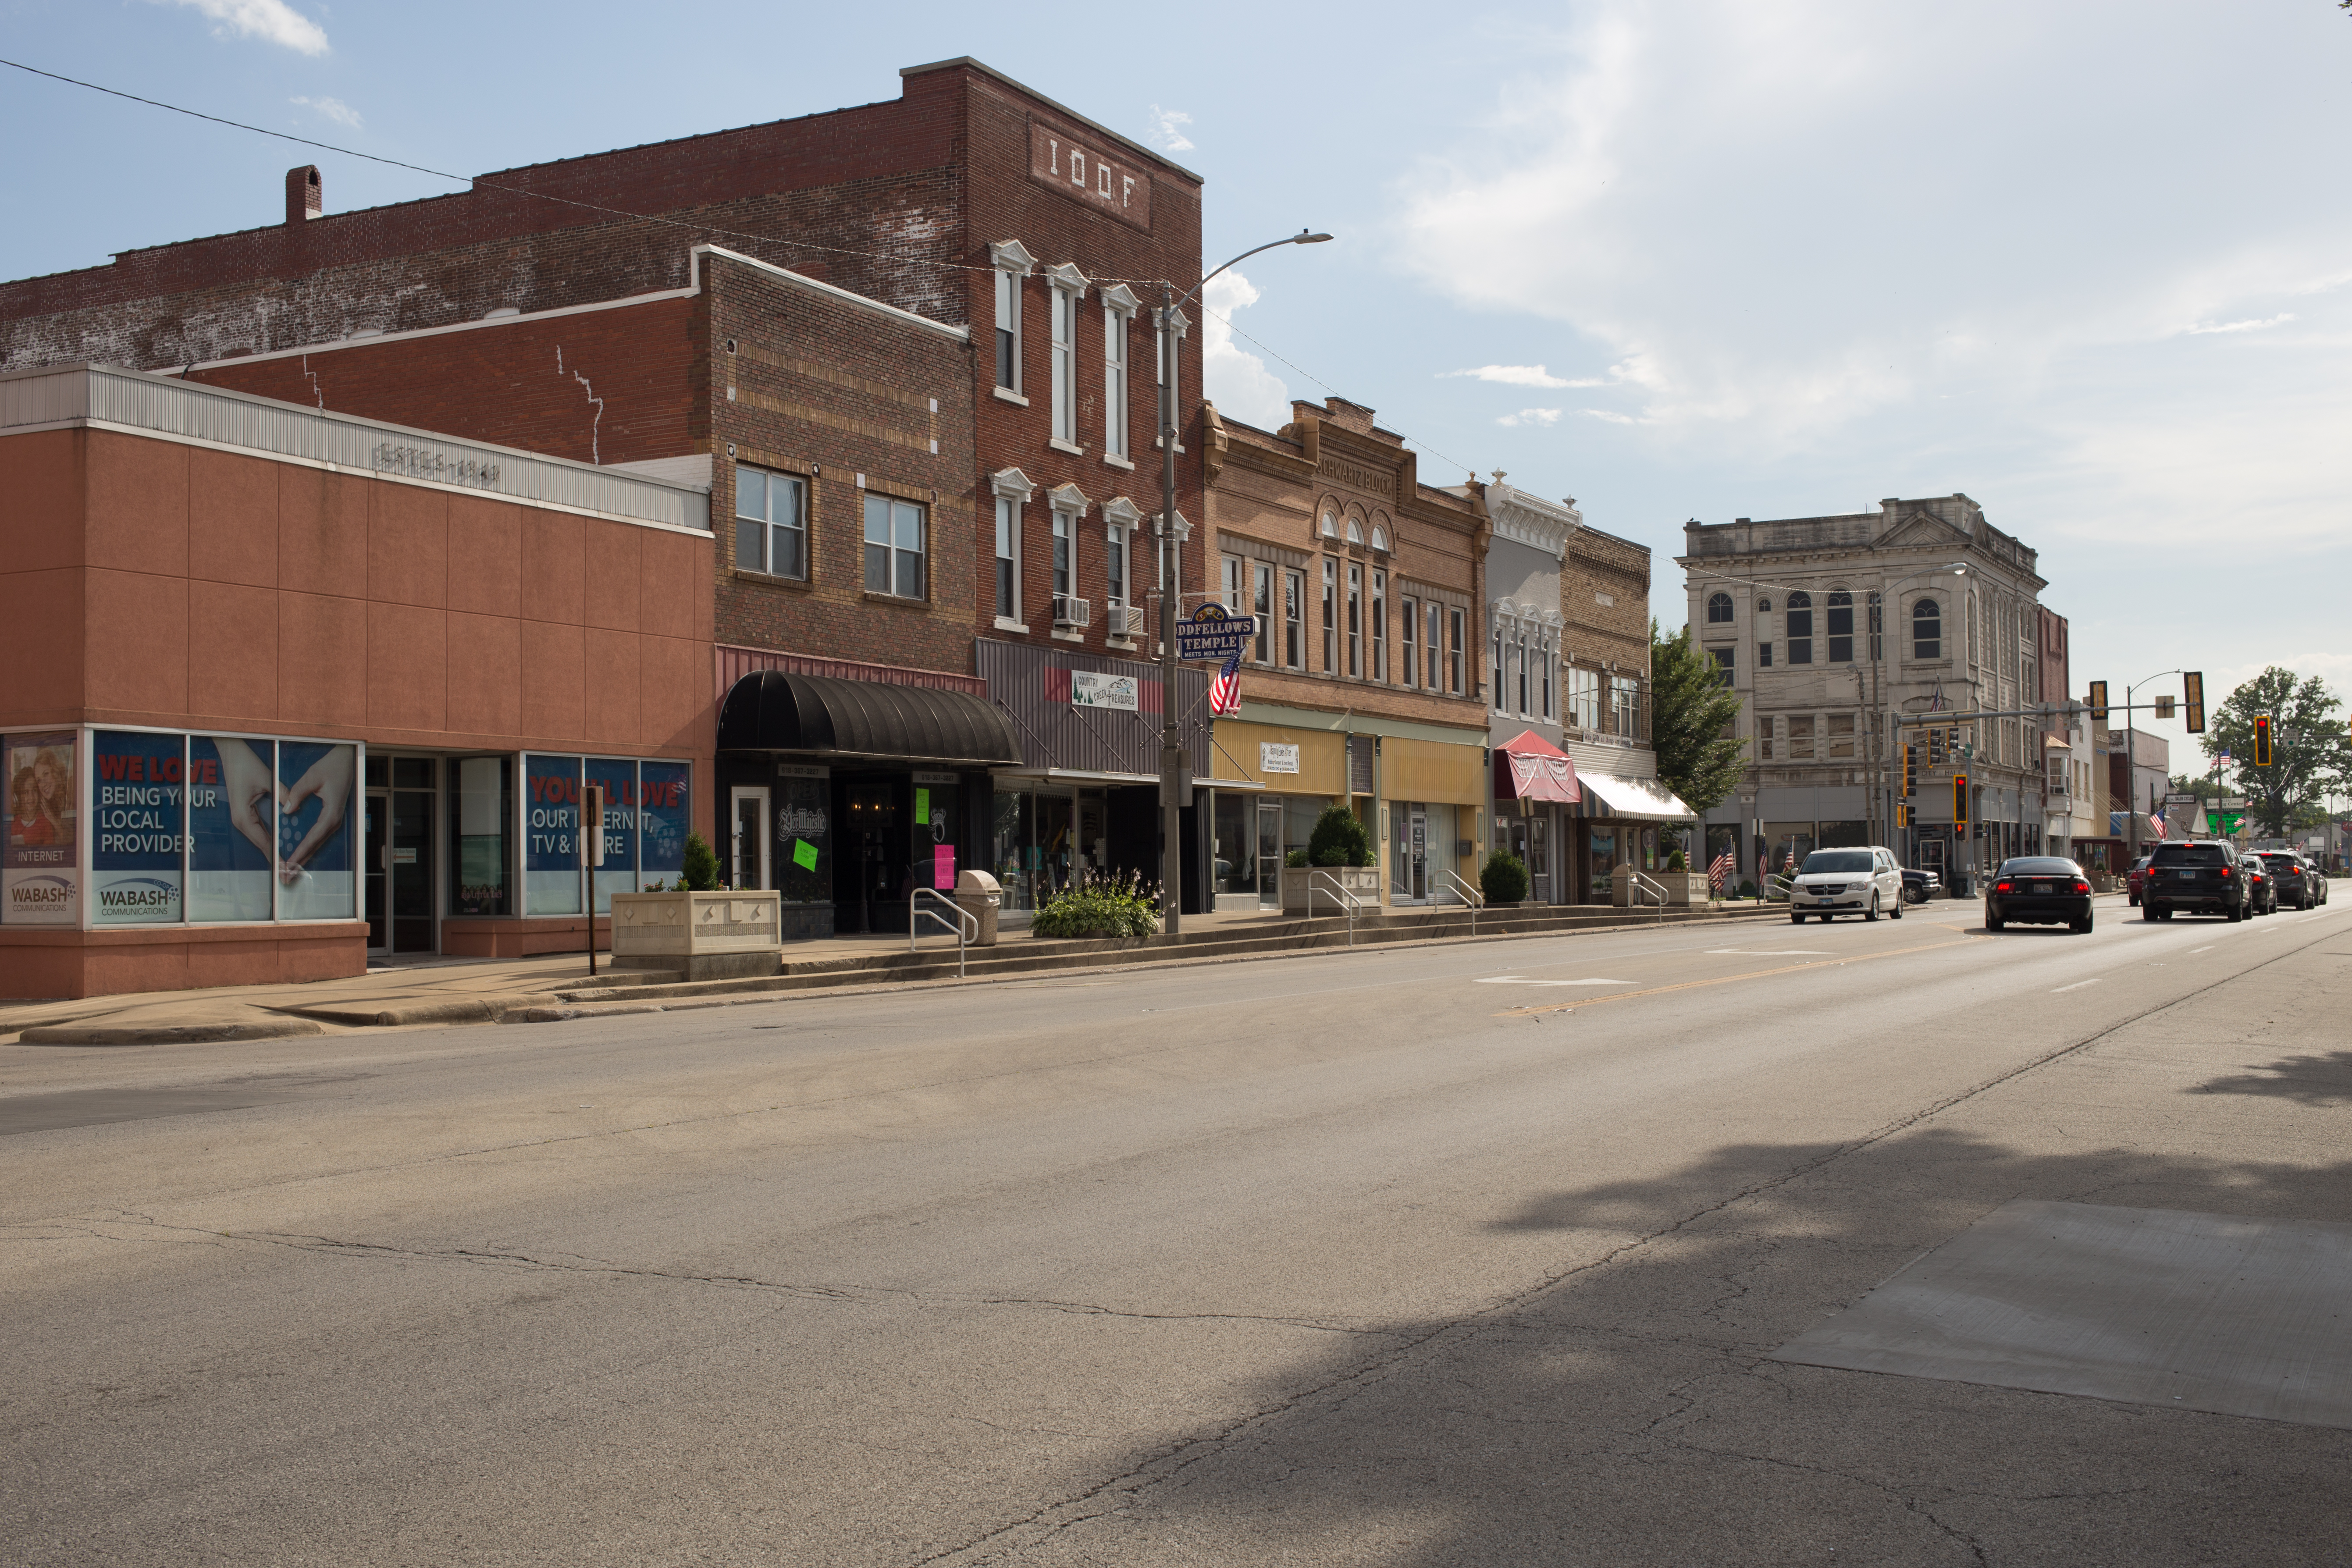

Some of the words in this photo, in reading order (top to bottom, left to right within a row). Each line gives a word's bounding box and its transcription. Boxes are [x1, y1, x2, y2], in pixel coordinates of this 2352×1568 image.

[1050, 139, 1135, 207] IOOF
[1317, 458, 1362, 487] SCHWARTZ
[1365, 471, 1391, 494] BLOCK
[1176, 621, 1250, 636] DDFELLOWS
[1185, 636, 1237, 650] TEMPLE
[1078, 676, 1098, 687] COUNTRY
[1094, 689, 1107, 702] CREEK
[98, 754, 143, 781] WE
[149, 756, 217, 784] LOVE
[102, 786, 160, 806] BEING
[529, 775, 616, 805] YOU'L
[623, 780, 678, 807] LOVE
[790, 782, 817, 800] OPEN
[102, 810, 164, 828] LOCAL
[532, 809, 568, 828] OUR
[575, 810, 653, 833] IERNT,
[533, 835, 555, 853] TV
[559, 835, 571, 853] &
[18, 850, 64, 862] INTERNET
[153, 879, 170, 889] CO-OP
[12, 888, 67, 902] WABASH
[100, 890, 168, 906] WABASH
[102, 907, 168, 916] COMMUNICATIONS
